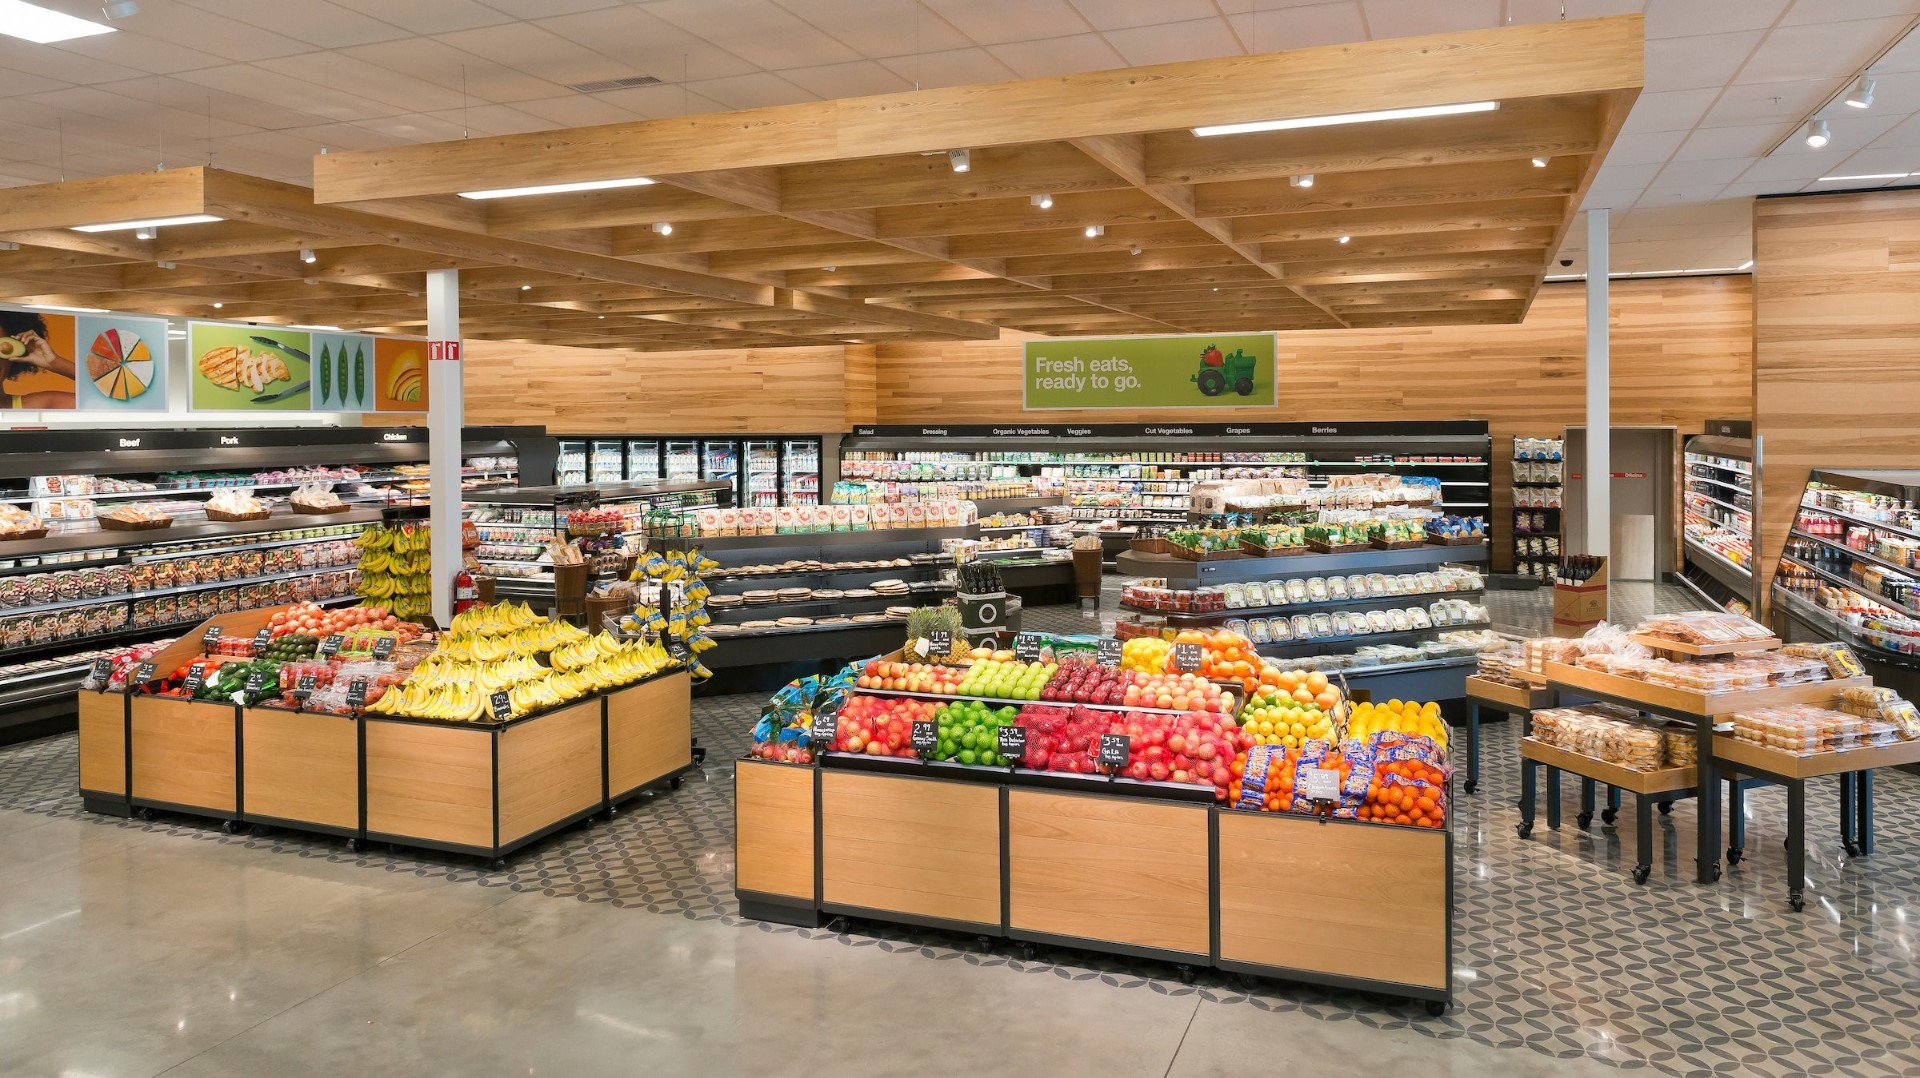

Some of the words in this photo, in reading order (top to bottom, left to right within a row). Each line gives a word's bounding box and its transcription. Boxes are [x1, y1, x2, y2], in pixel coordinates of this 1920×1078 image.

[1036, 357, 1084, 372] Fresh
[1090, 357, 1133, 374] eats,
[1036, 374, 1086, 392] ready
[1091, 374, 1109, 388] to
[1115, 376, 1141, 392] go.
[220, 436, 239, 445] Pork
[383, 433, 407, 441] Chicken
[119, 438, 141, 447] Beef
